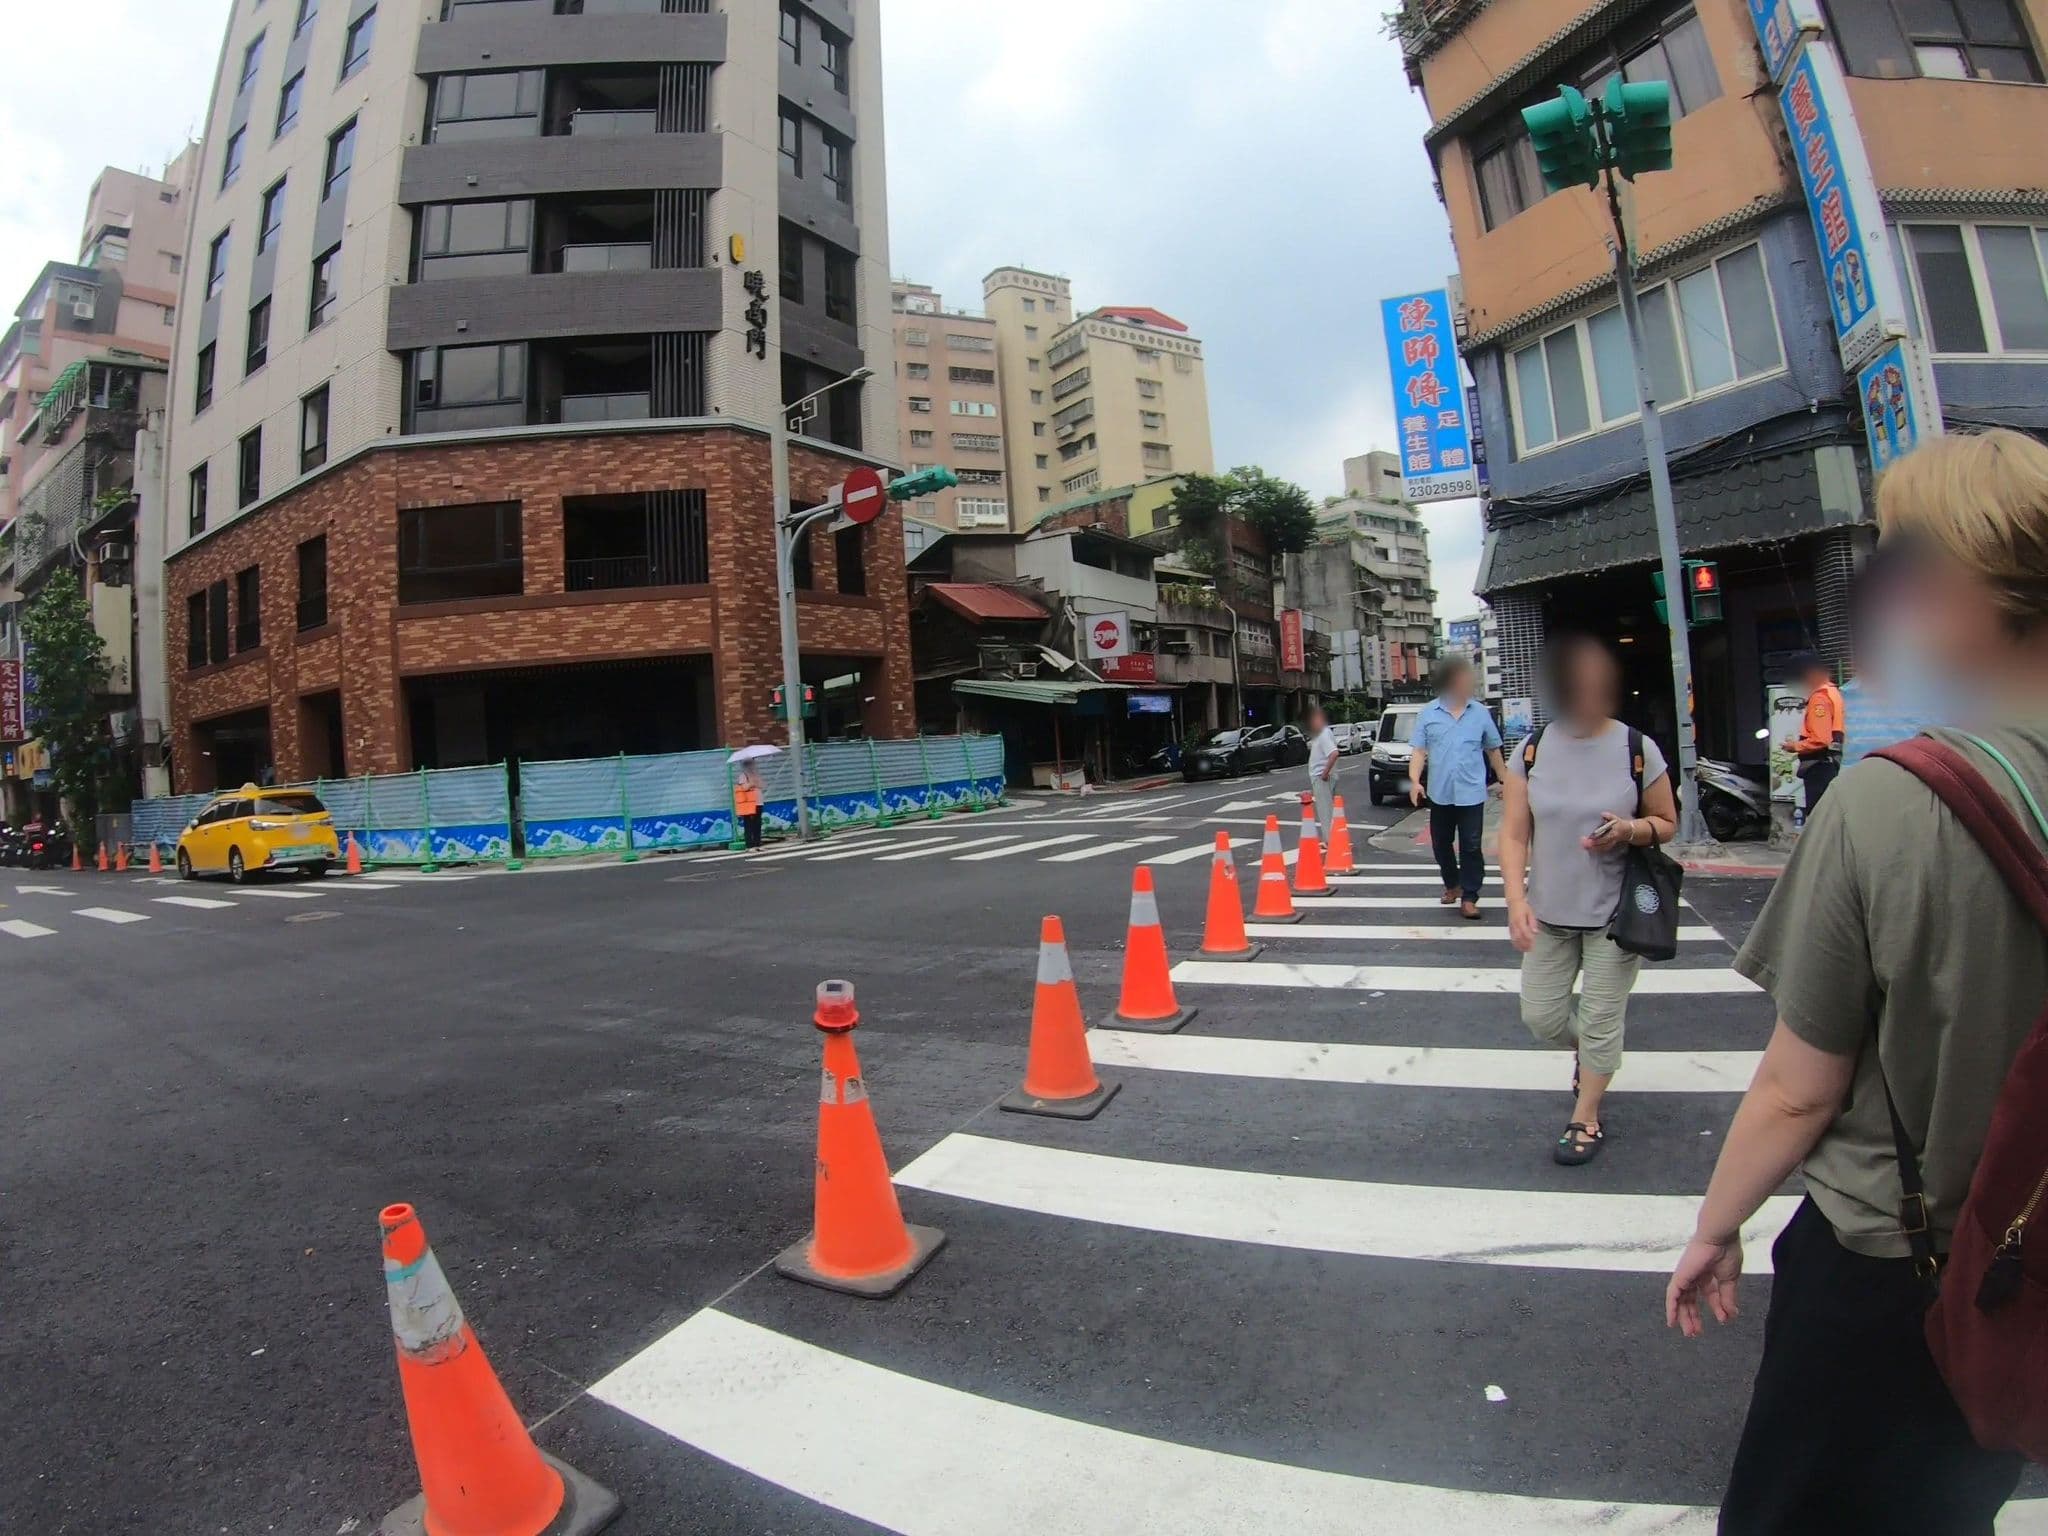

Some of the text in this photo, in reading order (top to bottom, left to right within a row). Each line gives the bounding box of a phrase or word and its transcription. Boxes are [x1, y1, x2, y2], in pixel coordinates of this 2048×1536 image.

[1789, 71, 1849, 259] 養生館
[1398, 297, 1449, 408] 陳師傅
[1408, 480, 1473, 497] 23029598
